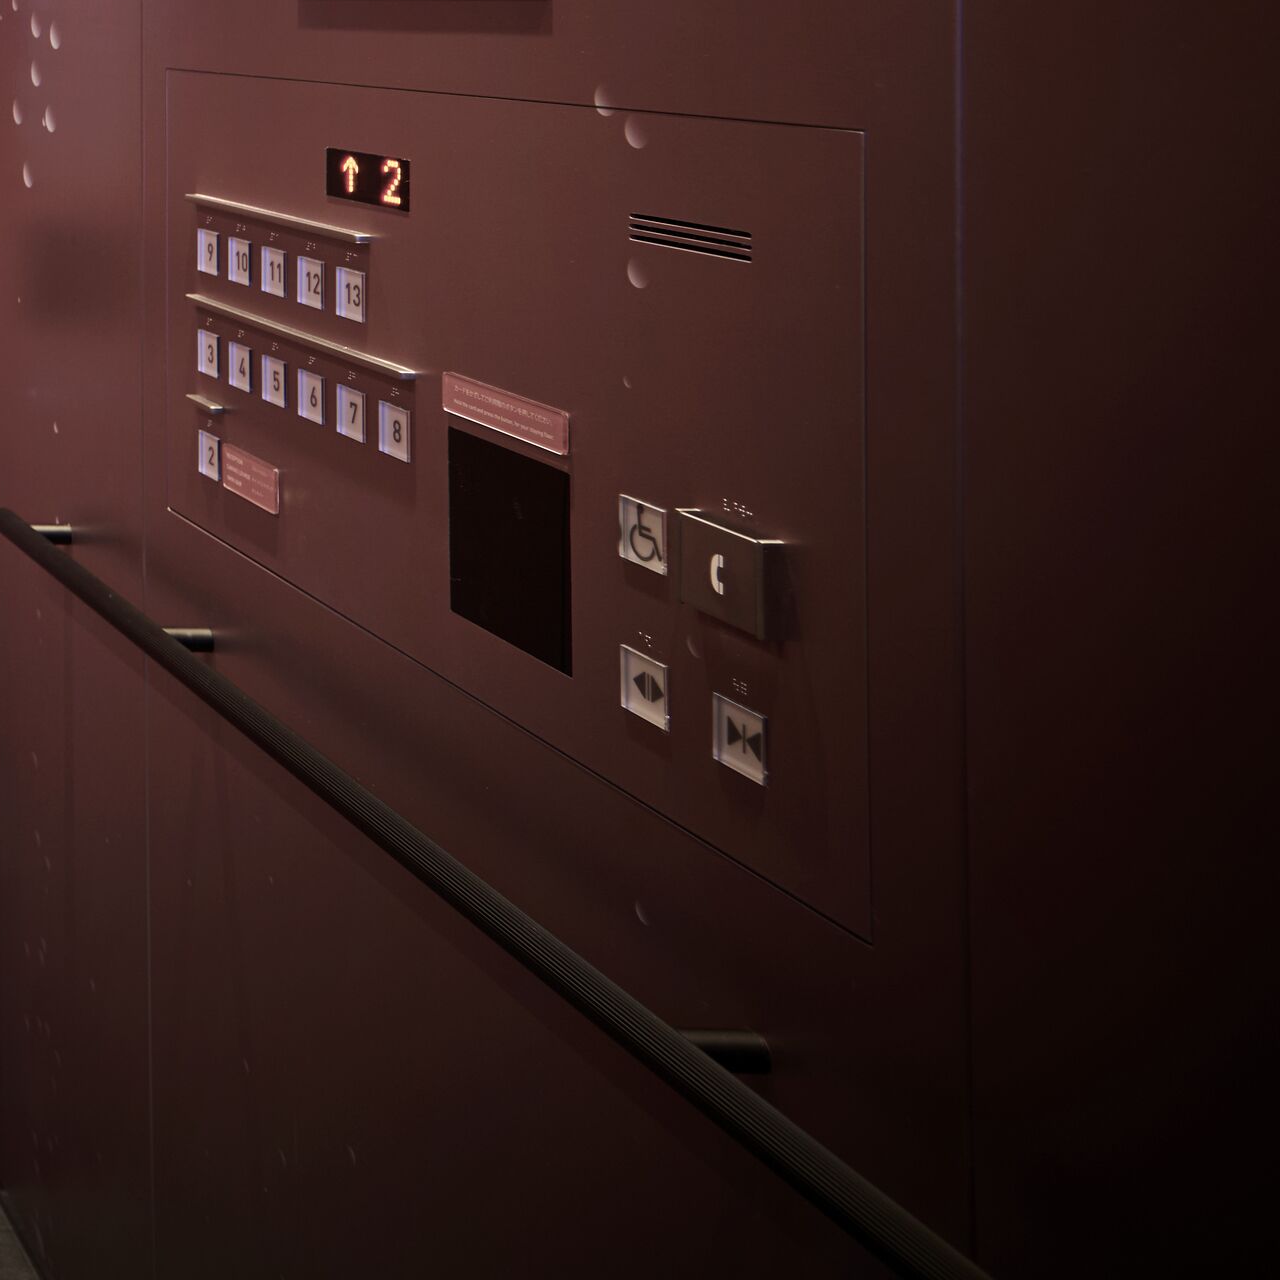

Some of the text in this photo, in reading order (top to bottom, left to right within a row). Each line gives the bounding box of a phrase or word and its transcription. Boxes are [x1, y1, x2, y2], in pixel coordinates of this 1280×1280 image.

[383, 160, 401, 205] 2
[207, 243, 214, 262] 9
[235, 251, 248, 273] 10
[269, 261, 282, 284] 11
[306, 271, 320, 295] 12
[345, 282, 361, 307] 13
[207, 344, 214, 364] 3
[239, 357, 246, 377] 4
[273, 371, 280, 391] 5
[310, 386, 317, 407] 6
[349, 402, 358, 424] 7
[392, 420, 402, 443] 8
[207, 446, 215, 466] 2
